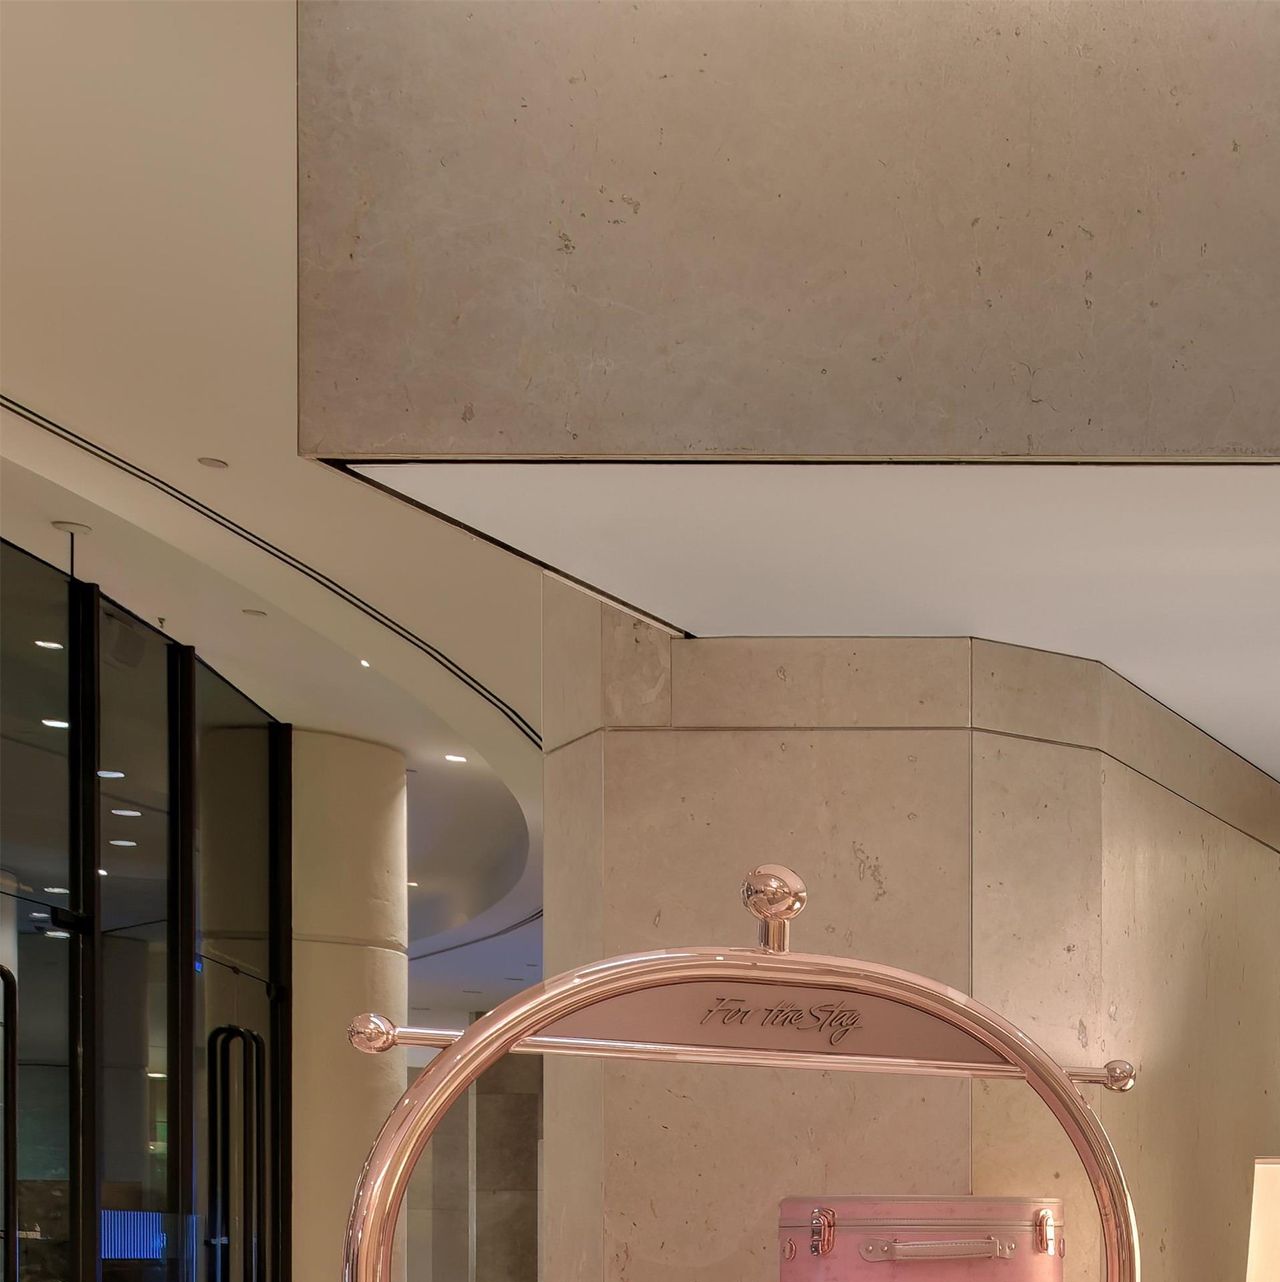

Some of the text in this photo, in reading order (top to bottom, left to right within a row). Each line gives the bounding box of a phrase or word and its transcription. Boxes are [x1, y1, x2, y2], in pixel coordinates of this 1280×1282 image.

[700, 997, 863, 1046] For the Stay
